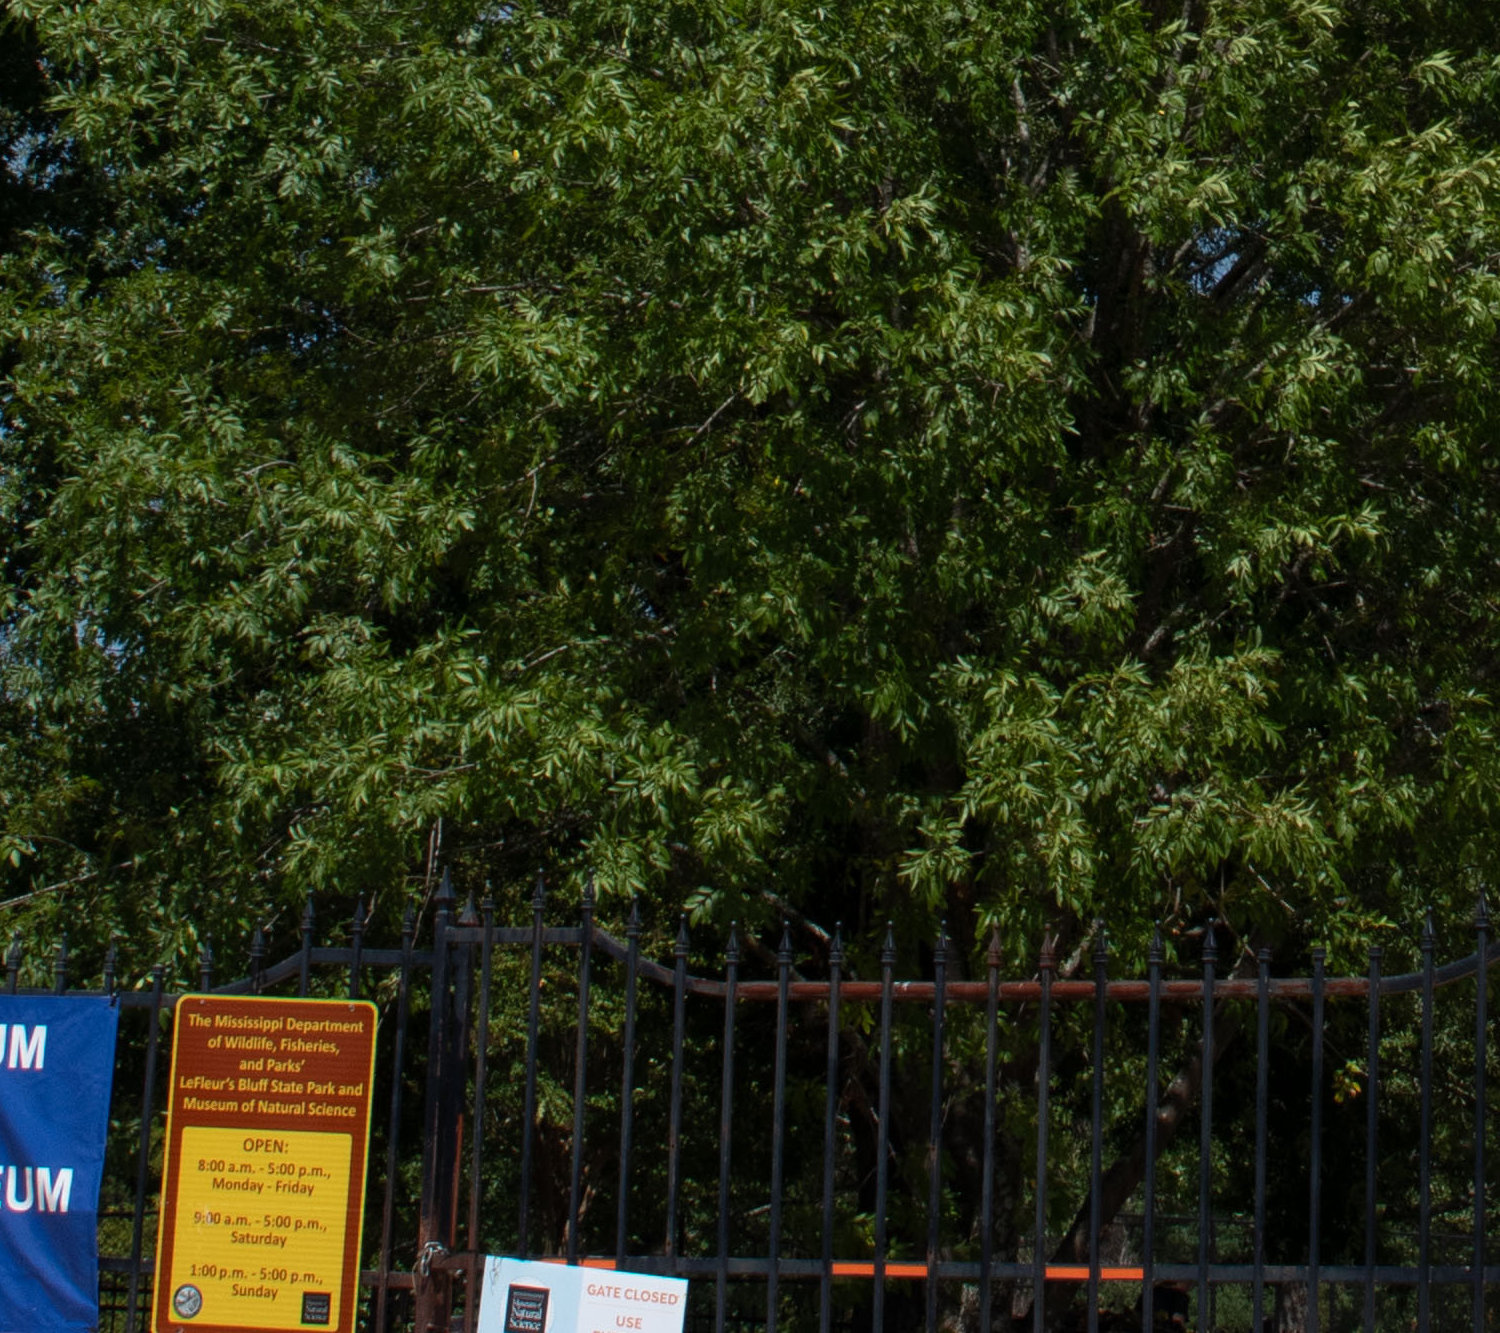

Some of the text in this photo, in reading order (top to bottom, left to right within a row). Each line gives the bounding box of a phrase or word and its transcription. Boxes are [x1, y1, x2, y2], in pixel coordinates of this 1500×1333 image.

[188, 1014, 364, 1034] The Mississippi Department
[208, 1035, 340, 1055] of Wildlife, Fisheries,
[239, 1058, 263, 1071] and
[180, 1076, 363, 1096] LeFleur's Bluff State Park and
[183, 1097, 357, 1117] Museum of Natural Science
[243, 1137, 289, 1153] OPEN:
[197, 1159, 225, 1172] 8:00
[228, 1161, 256, 1174] a.m.
[268, 1162, 295, 1176] 5:00
[212, 1177, 264, 1194] Monday
[276, 1180, 314, 1197] Friday
[194, 1211, 221, 1225] 9:00
[224, 1214, 252, 1226] a.m.
[264, 1215, 291, 1229] 5:00
[231, 1231, 287, 1248] Saturday
[190, 1264, 217, 1278] 1:00
[220, 1267, 248, 1280] p.m.
[260, 1267, 287, 1281] 5:00
[232, 1283, 278, 1301] Sunday
[587, 1284, 679, 1305] GATE CLOSED
[615, 1315, 643, 1329] USE
